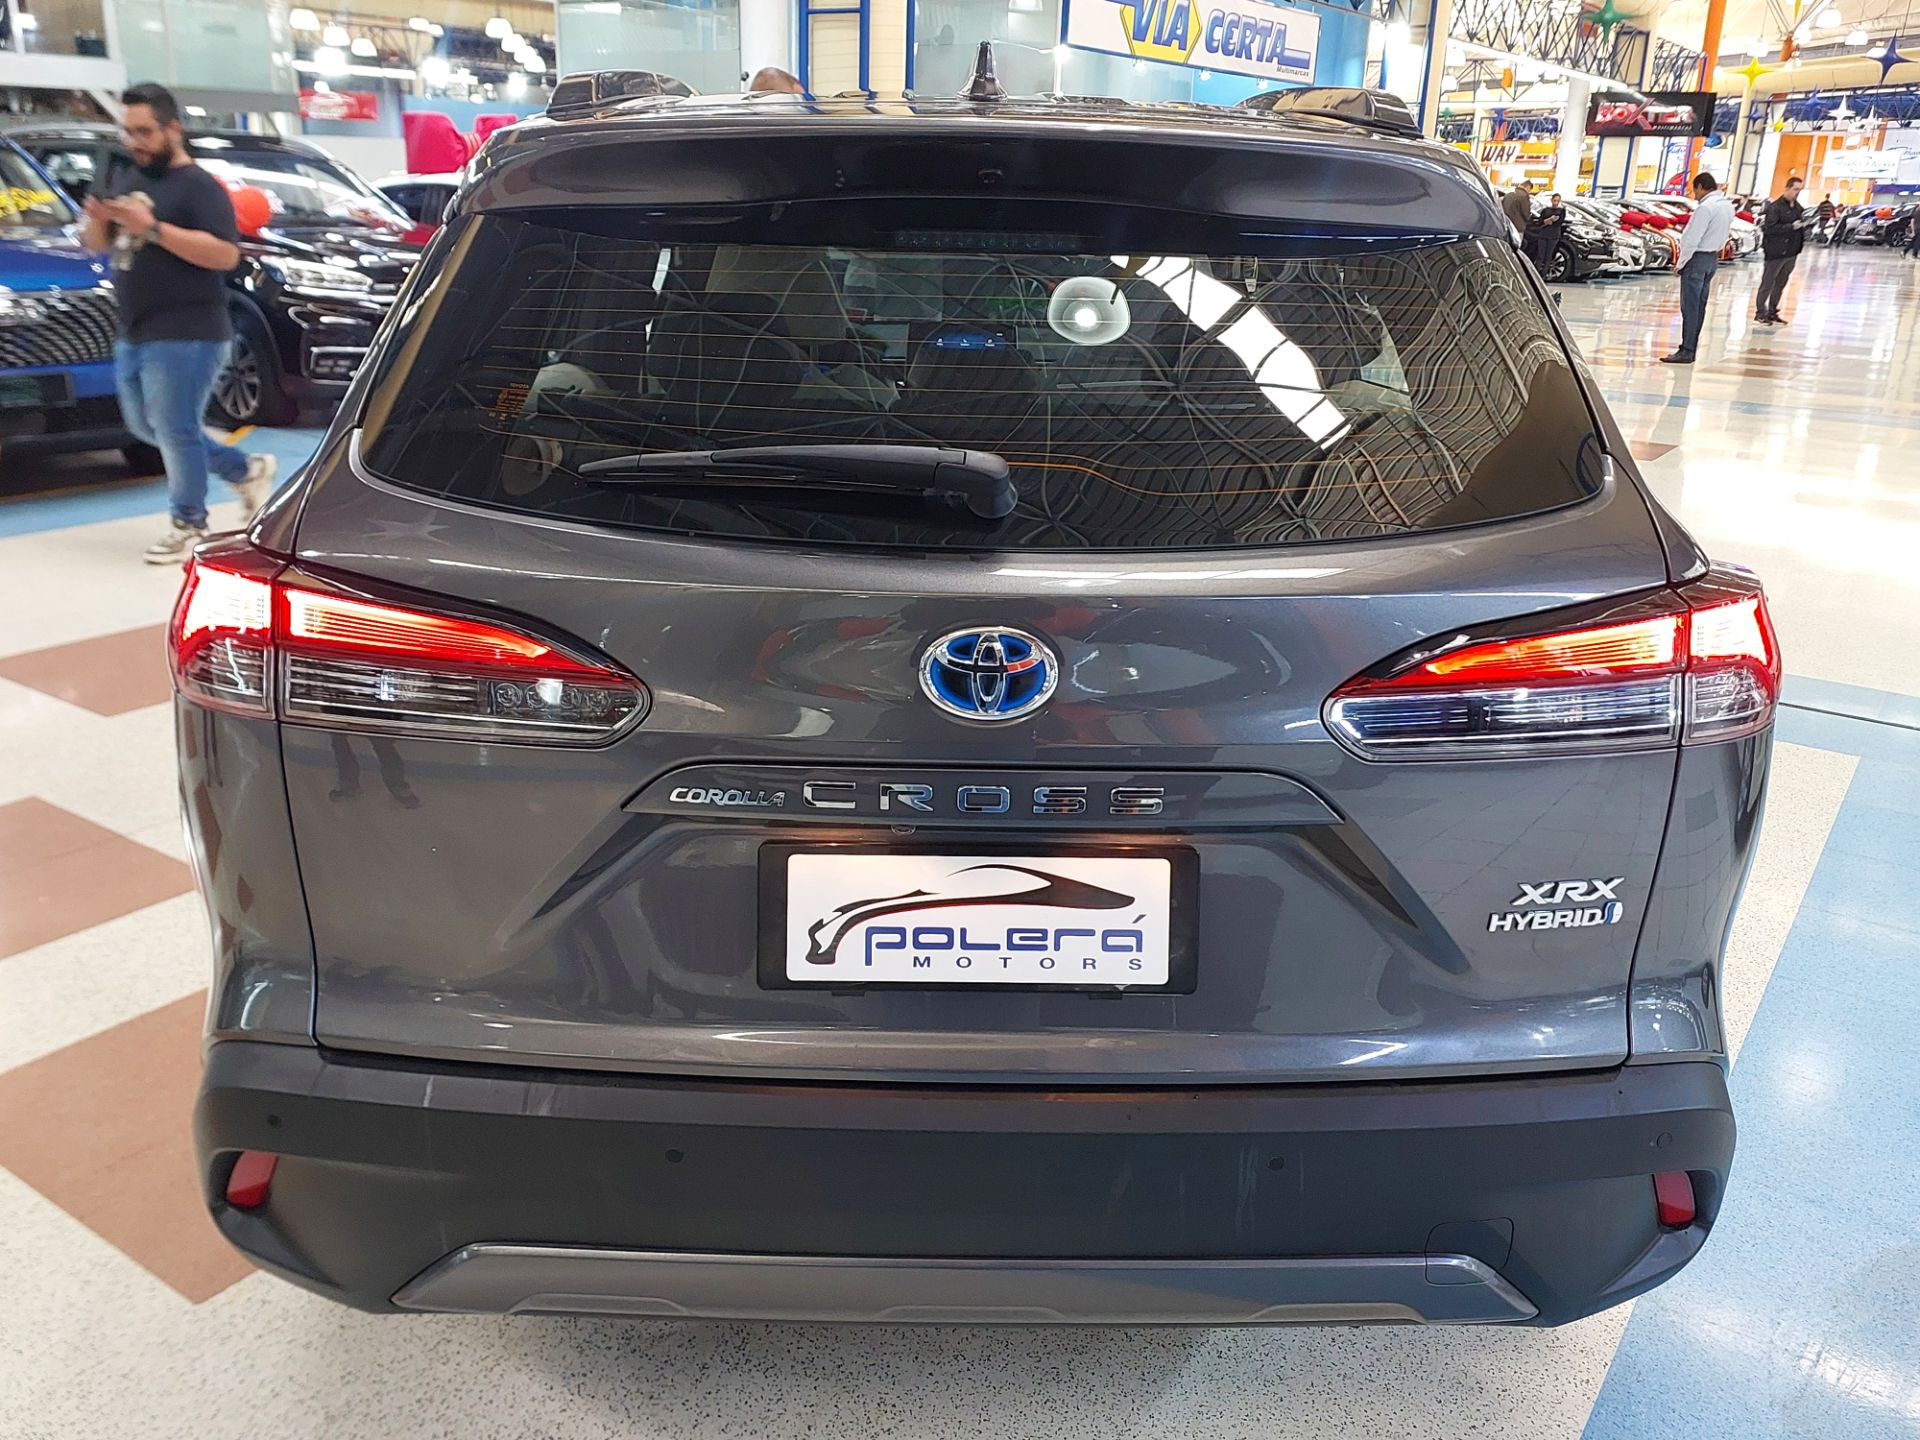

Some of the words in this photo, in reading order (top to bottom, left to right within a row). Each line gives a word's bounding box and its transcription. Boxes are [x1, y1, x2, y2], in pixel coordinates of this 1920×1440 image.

[1112, 0, 1191, 51] VIA
[1204, 9, 1311, 69] CERTA
[1481, 145, 1517, 163] WAY
[669, 786, 786, 809] COROLLA
[802, 781, 1165, 815] CROSS
[1511, 876, 1625, 906] XRX
[1488, 908, 1604, 932] HYBRID
[913, 955, 1143, 972] MOTORS
